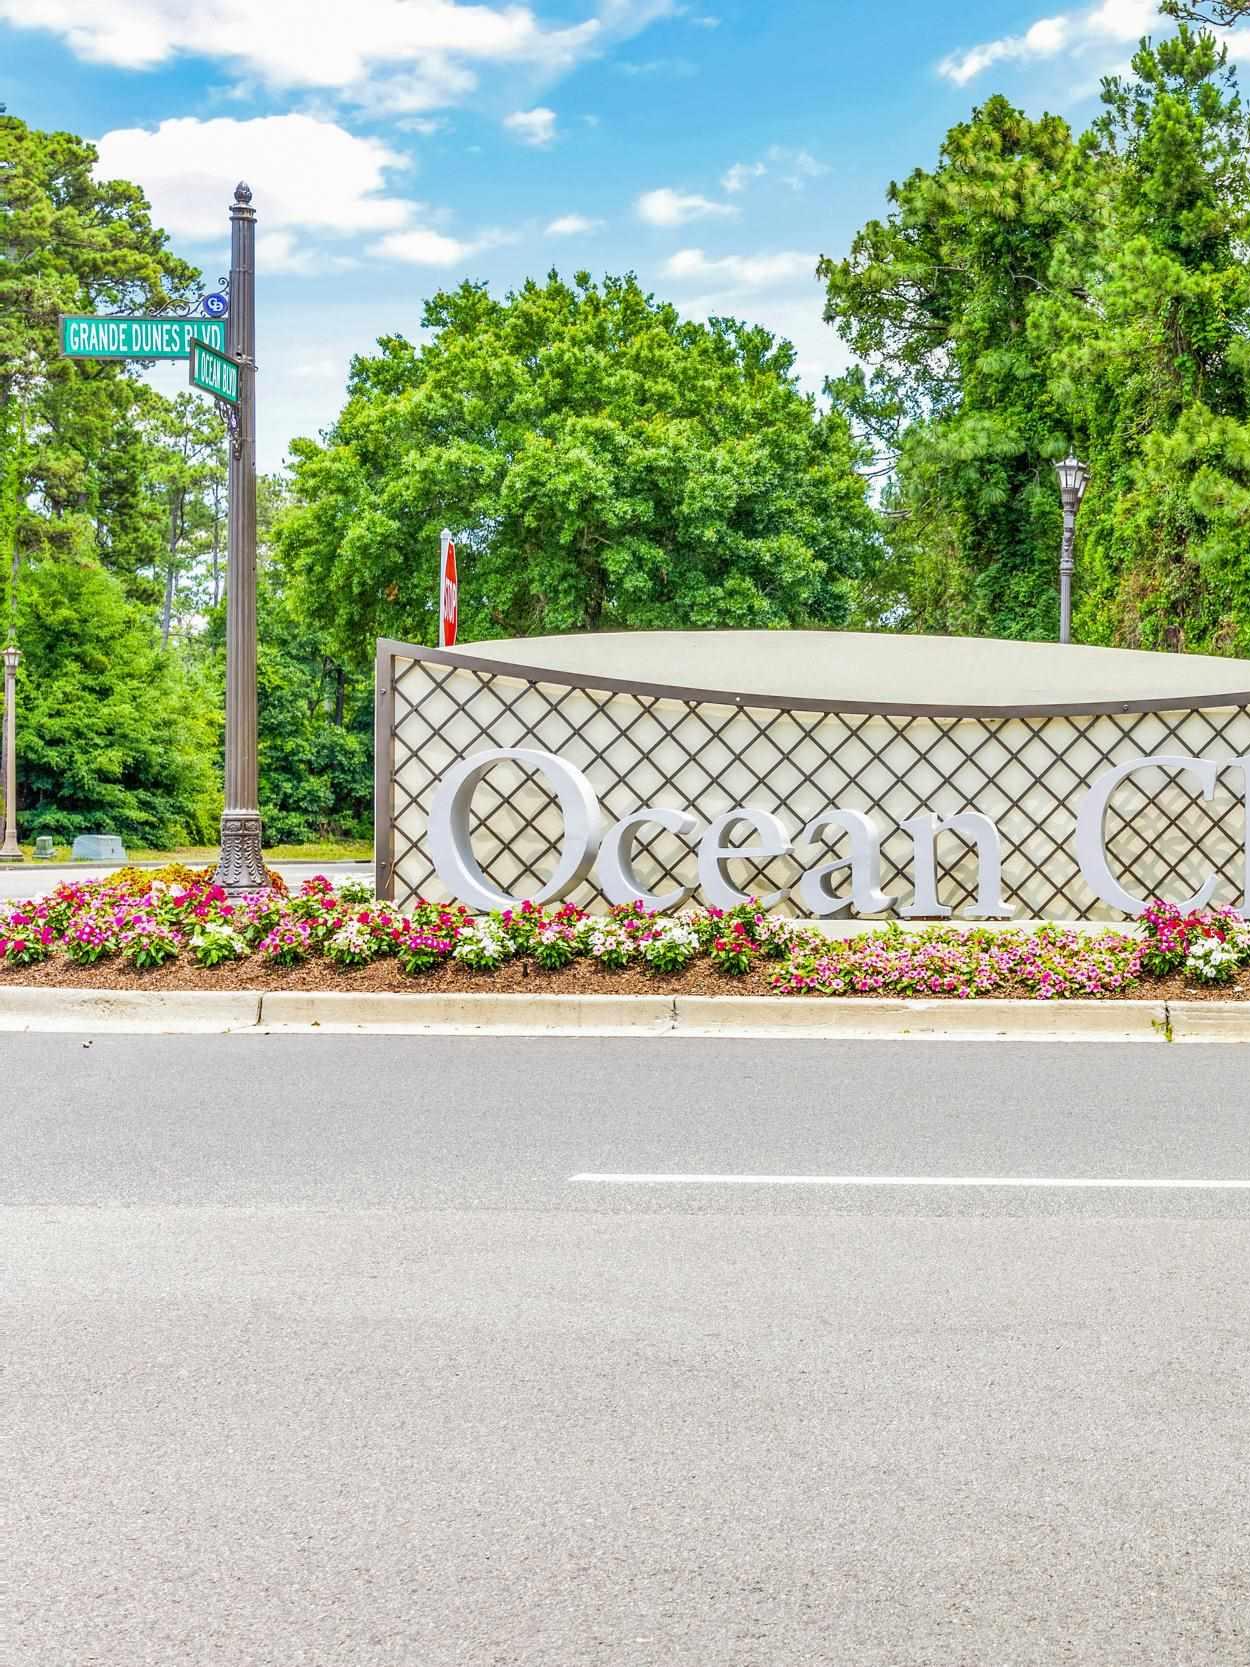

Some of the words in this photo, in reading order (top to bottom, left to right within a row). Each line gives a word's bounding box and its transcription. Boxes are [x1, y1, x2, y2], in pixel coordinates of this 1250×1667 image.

[70, 323, 128, 351] GRANDE
[131, 323, 180, 352] DUNES
[201, 352, 221, 387] OCEAN
[222, 363, 237, 397] BLVD
[427, 747, 1016, 917] Ocean
